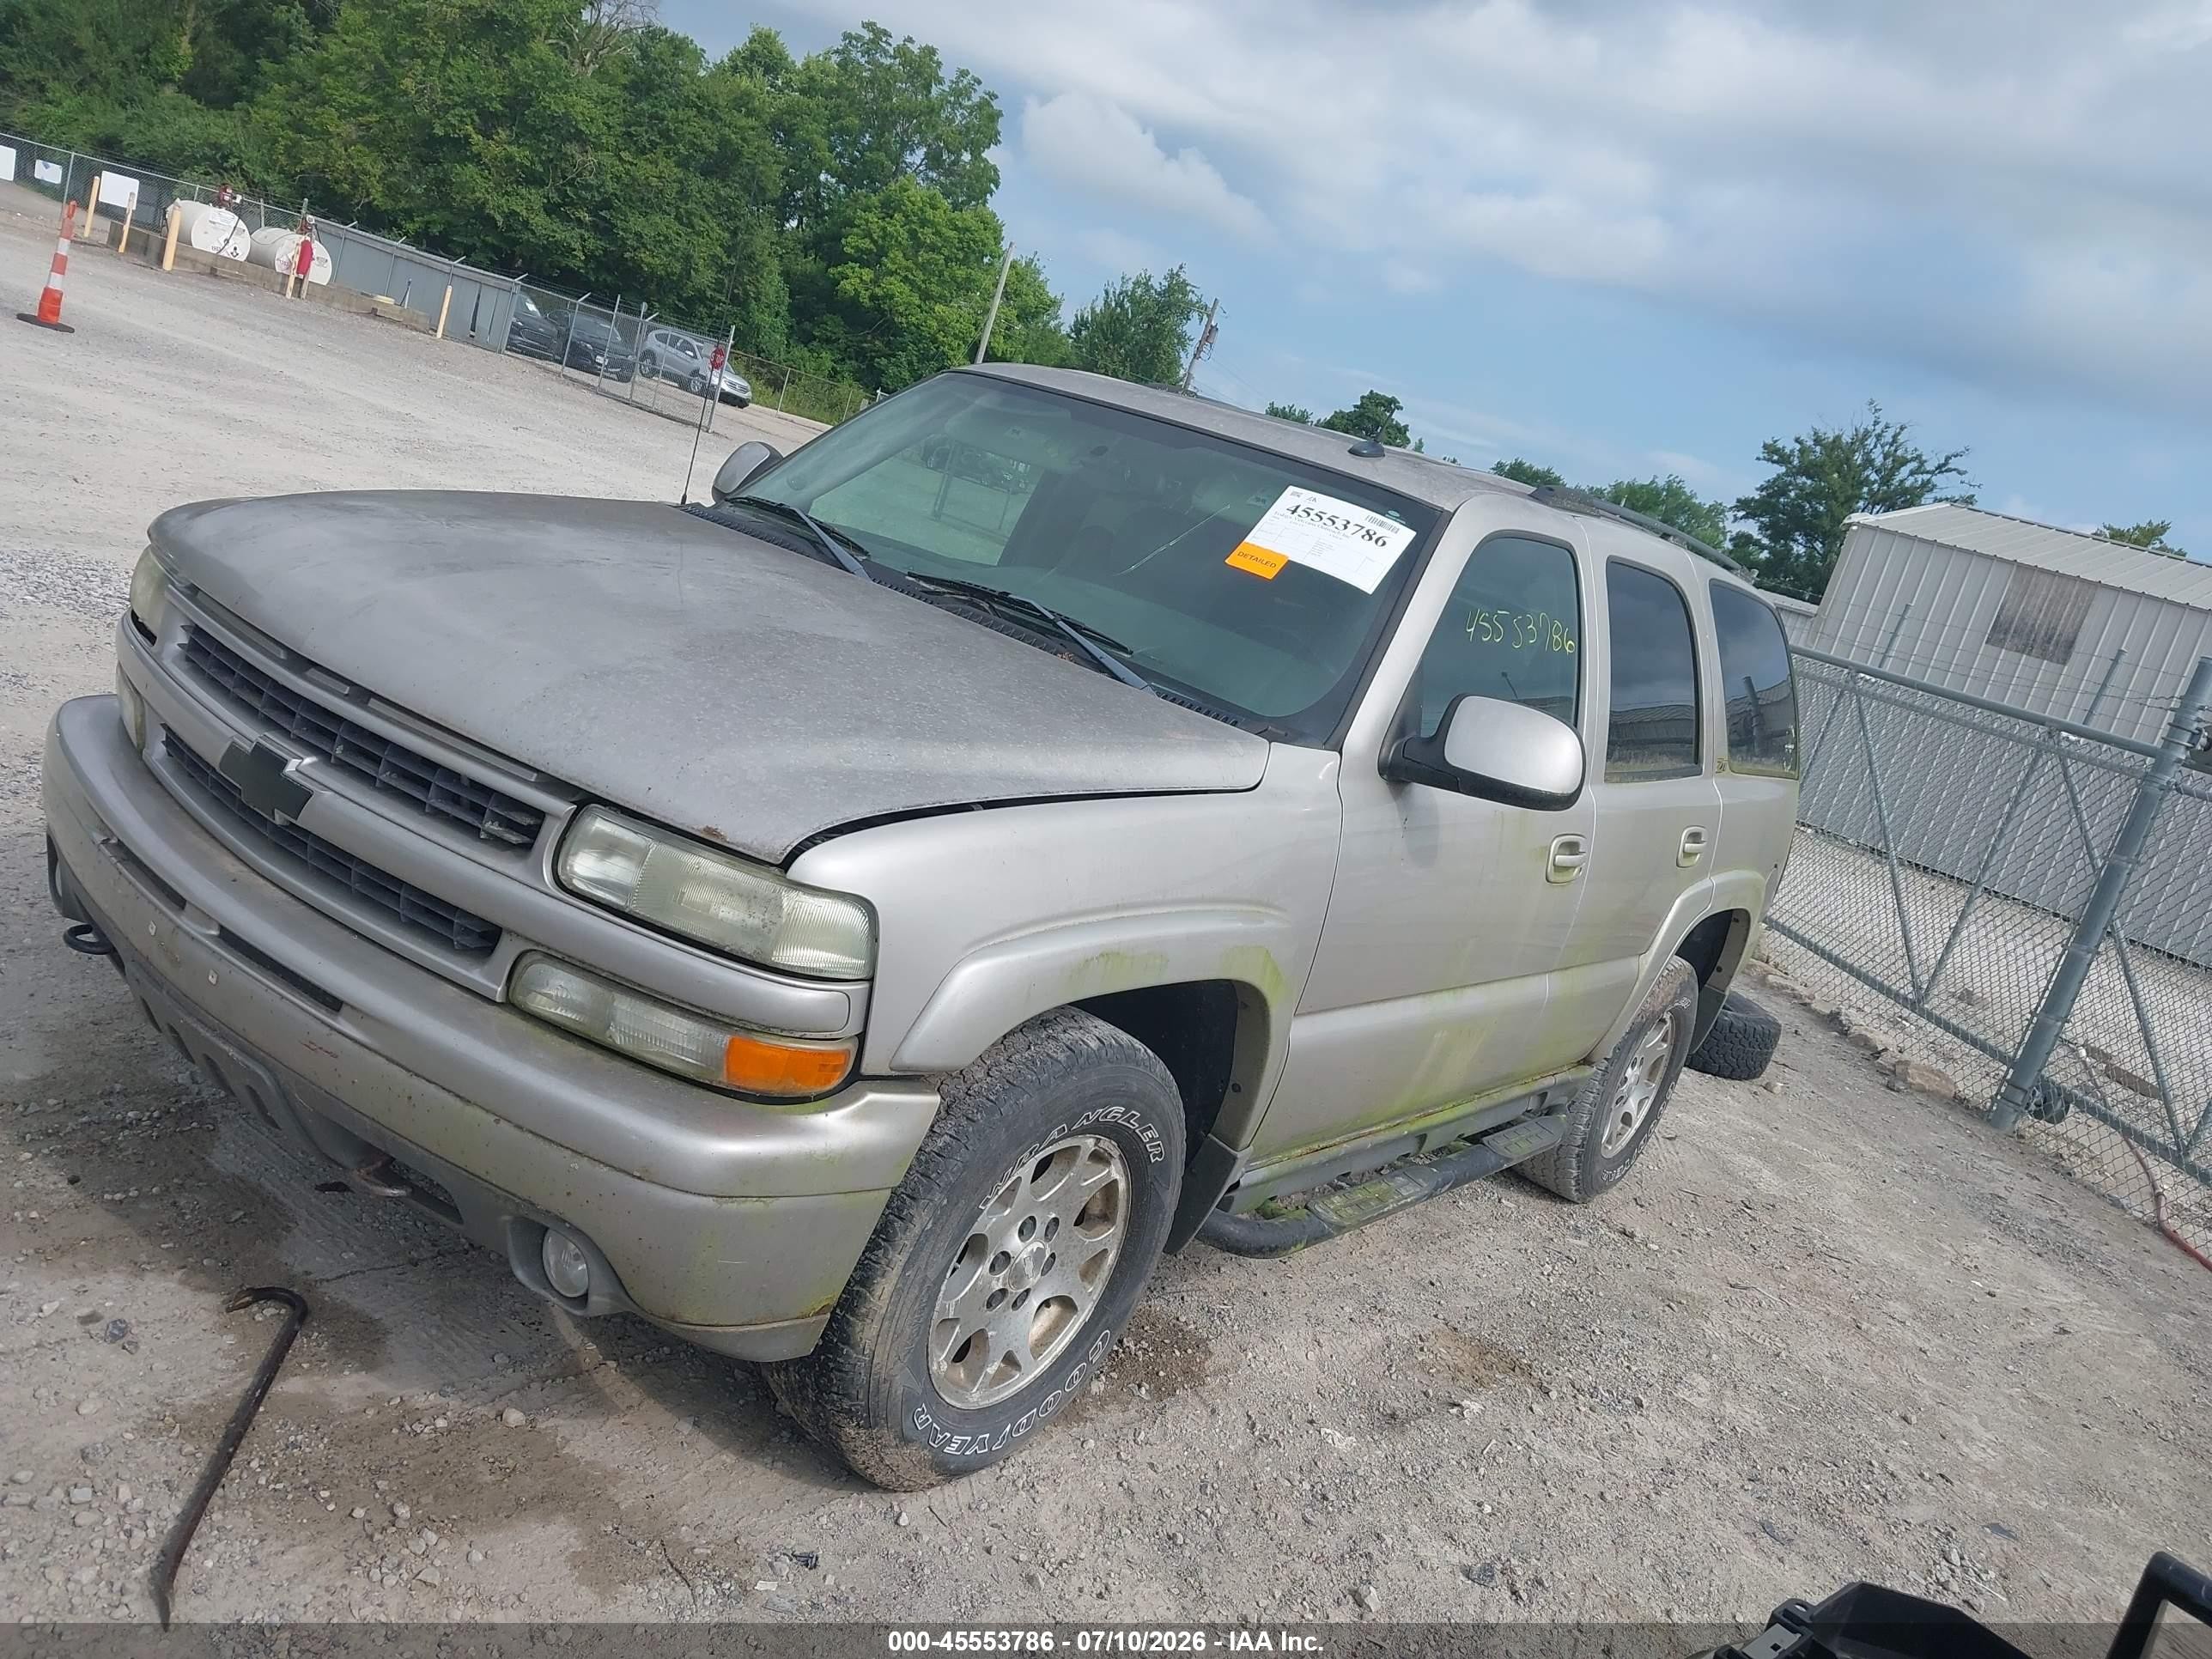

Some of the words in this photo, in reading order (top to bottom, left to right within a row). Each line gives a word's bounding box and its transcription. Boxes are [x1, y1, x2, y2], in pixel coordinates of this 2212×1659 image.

[1286, 504, 1389, 547] 45553786
[1237, 550, 1277, 569] DETAILED
[1465, 609, 1576, 655] 45553786
[914, 1329, 1110, 1455] GOODYEAR
